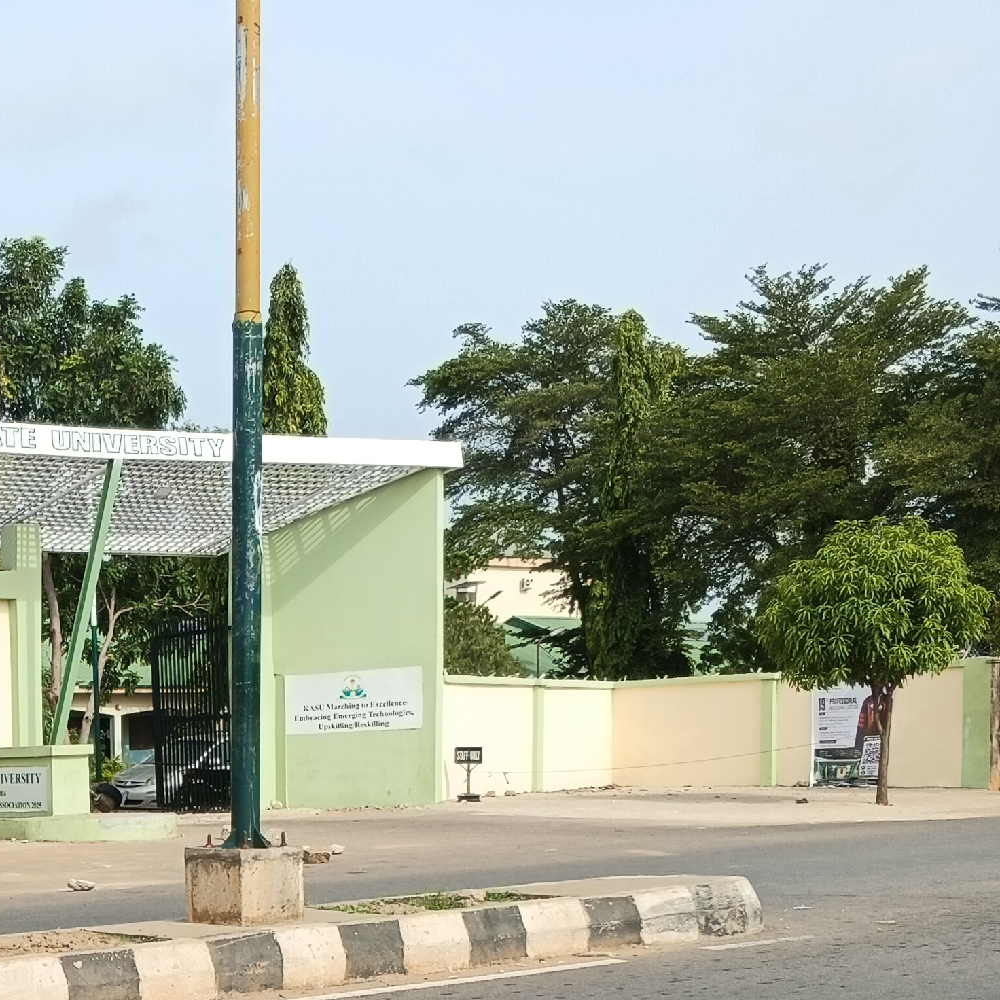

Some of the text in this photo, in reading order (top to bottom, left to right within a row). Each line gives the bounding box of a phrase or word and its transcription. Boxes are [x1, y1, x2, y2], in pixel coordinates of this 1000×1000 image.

[51, 429, 225, 458] UNIVERSITY
[303, 704, 325, 712] KASU
[326, 702, 360, 711] Marching
[818, 697, 826, 711] 19
[294, 713, 332, 722] Embracing
[333, 711, 367, 720] Emerging
[318, 720, 390, 731] Upskilling/Reskilling
[457, 750, 480, 760] STAFF ONLY
